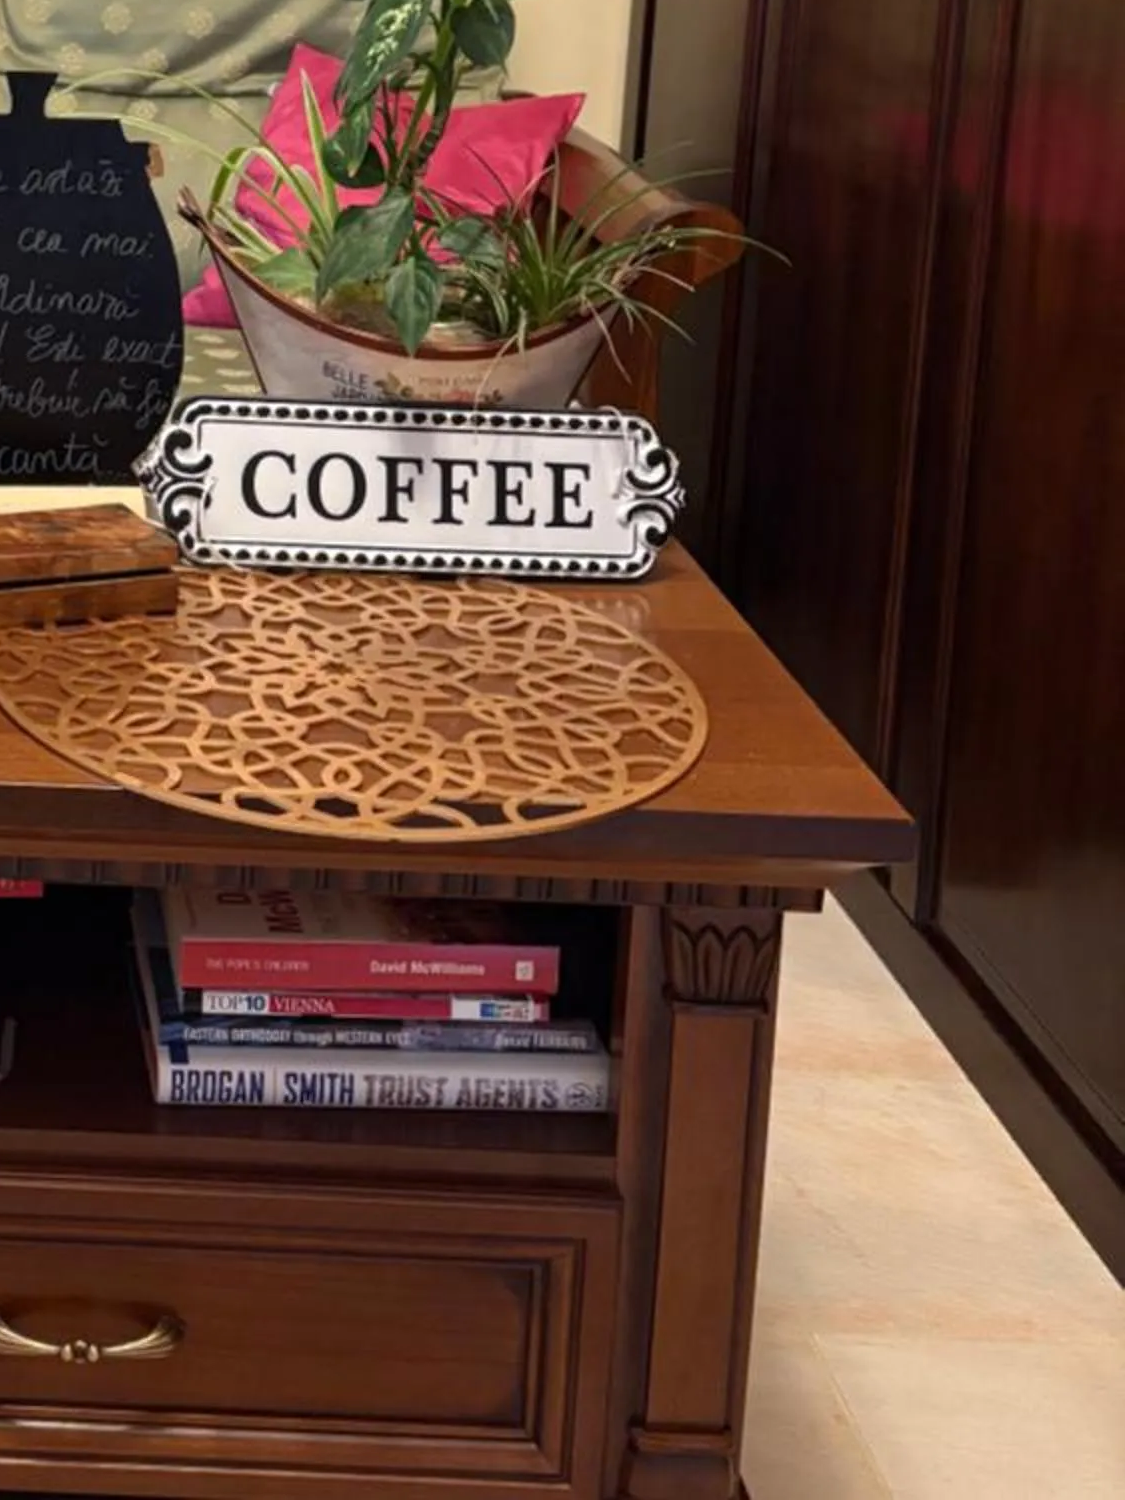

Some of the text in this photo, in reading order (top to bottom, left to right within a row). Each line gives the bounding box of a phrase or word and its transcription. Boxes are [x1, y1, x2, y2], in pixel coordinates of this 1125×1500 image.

[240, 450, 594, 530] COFFEE
[370, 959, 485, 975] David McWilliams
[269, 996, 336, 1013] VIENNA
[170, 1069, 558, 1109] BROGAN SMITH TRUST AGENTS
